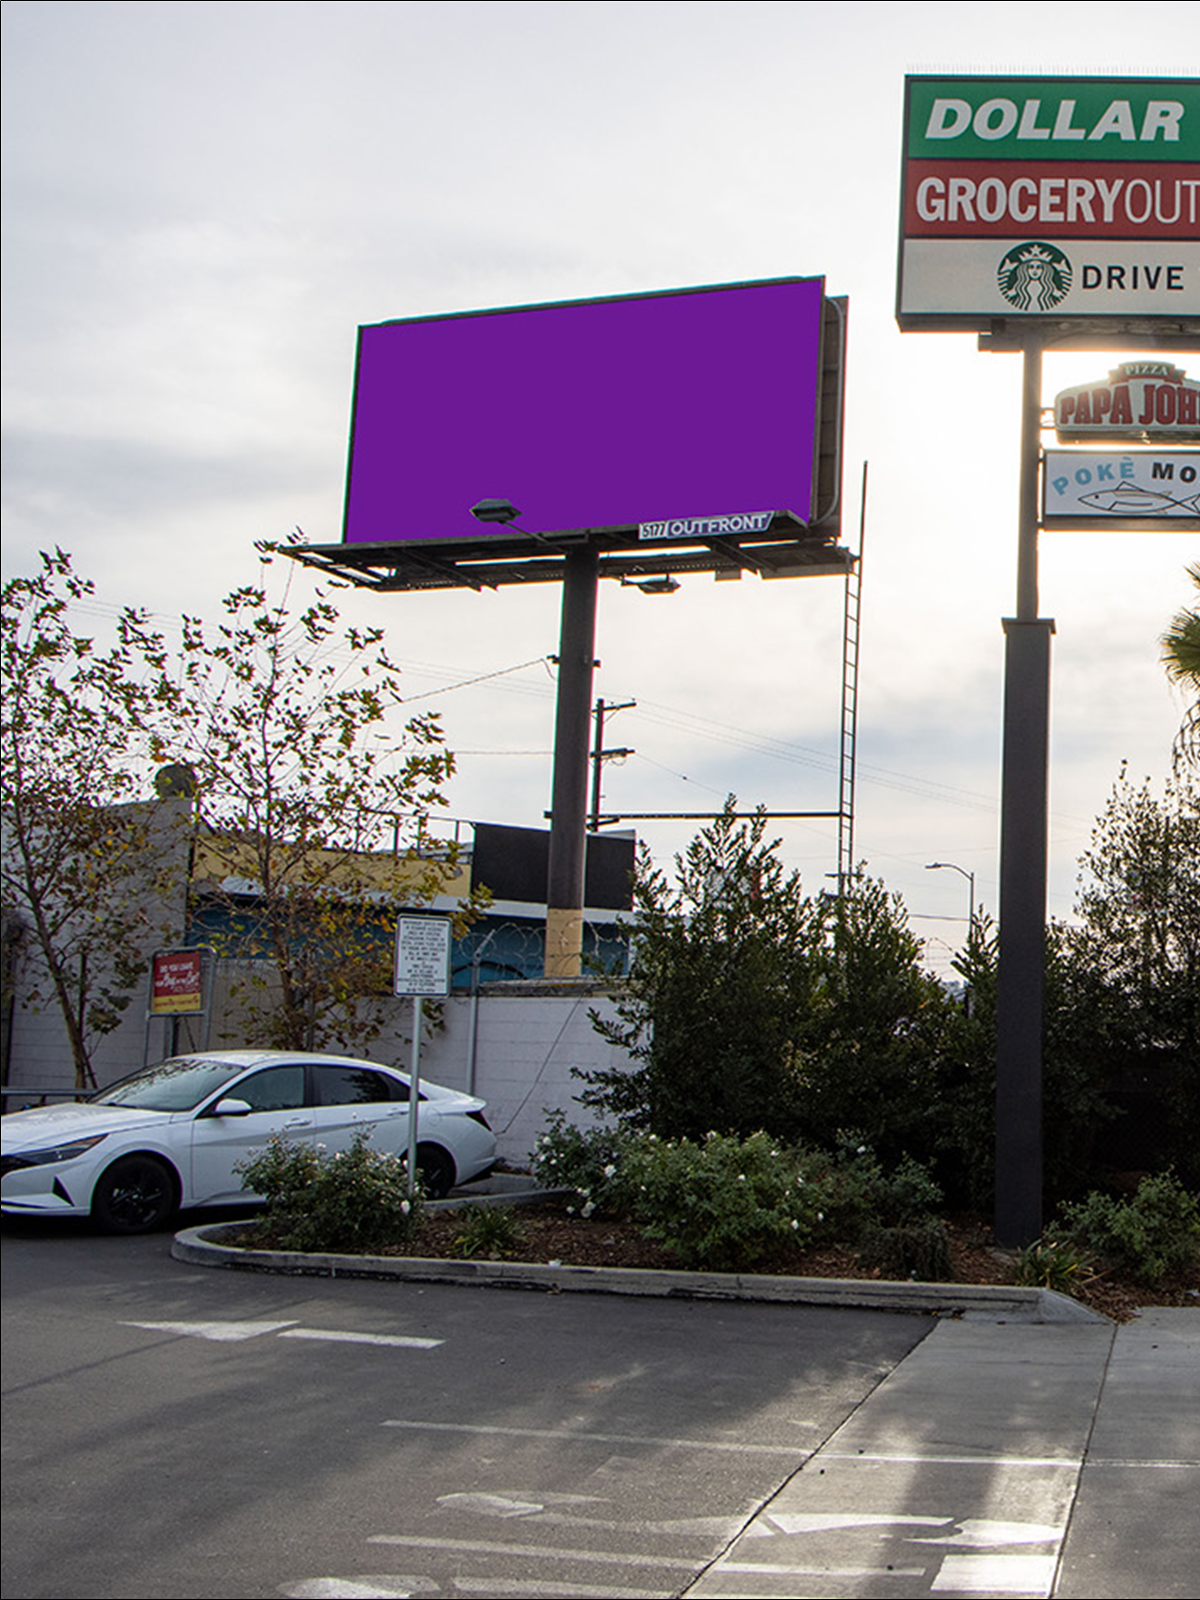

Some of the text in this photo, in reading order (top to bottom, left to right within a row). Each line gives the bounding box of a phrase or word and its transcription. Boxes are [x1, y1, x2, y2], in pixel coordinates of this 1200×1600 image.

[924, 98, 1185, 142] DOLLAR
[1082, 265, 1185, 291] DRIVE
[1125, 364, 1169, 376] PIZZA
[1060, 385, 1134, 425] PAPA
[671, 514, 768, 536] OUTFRONT
